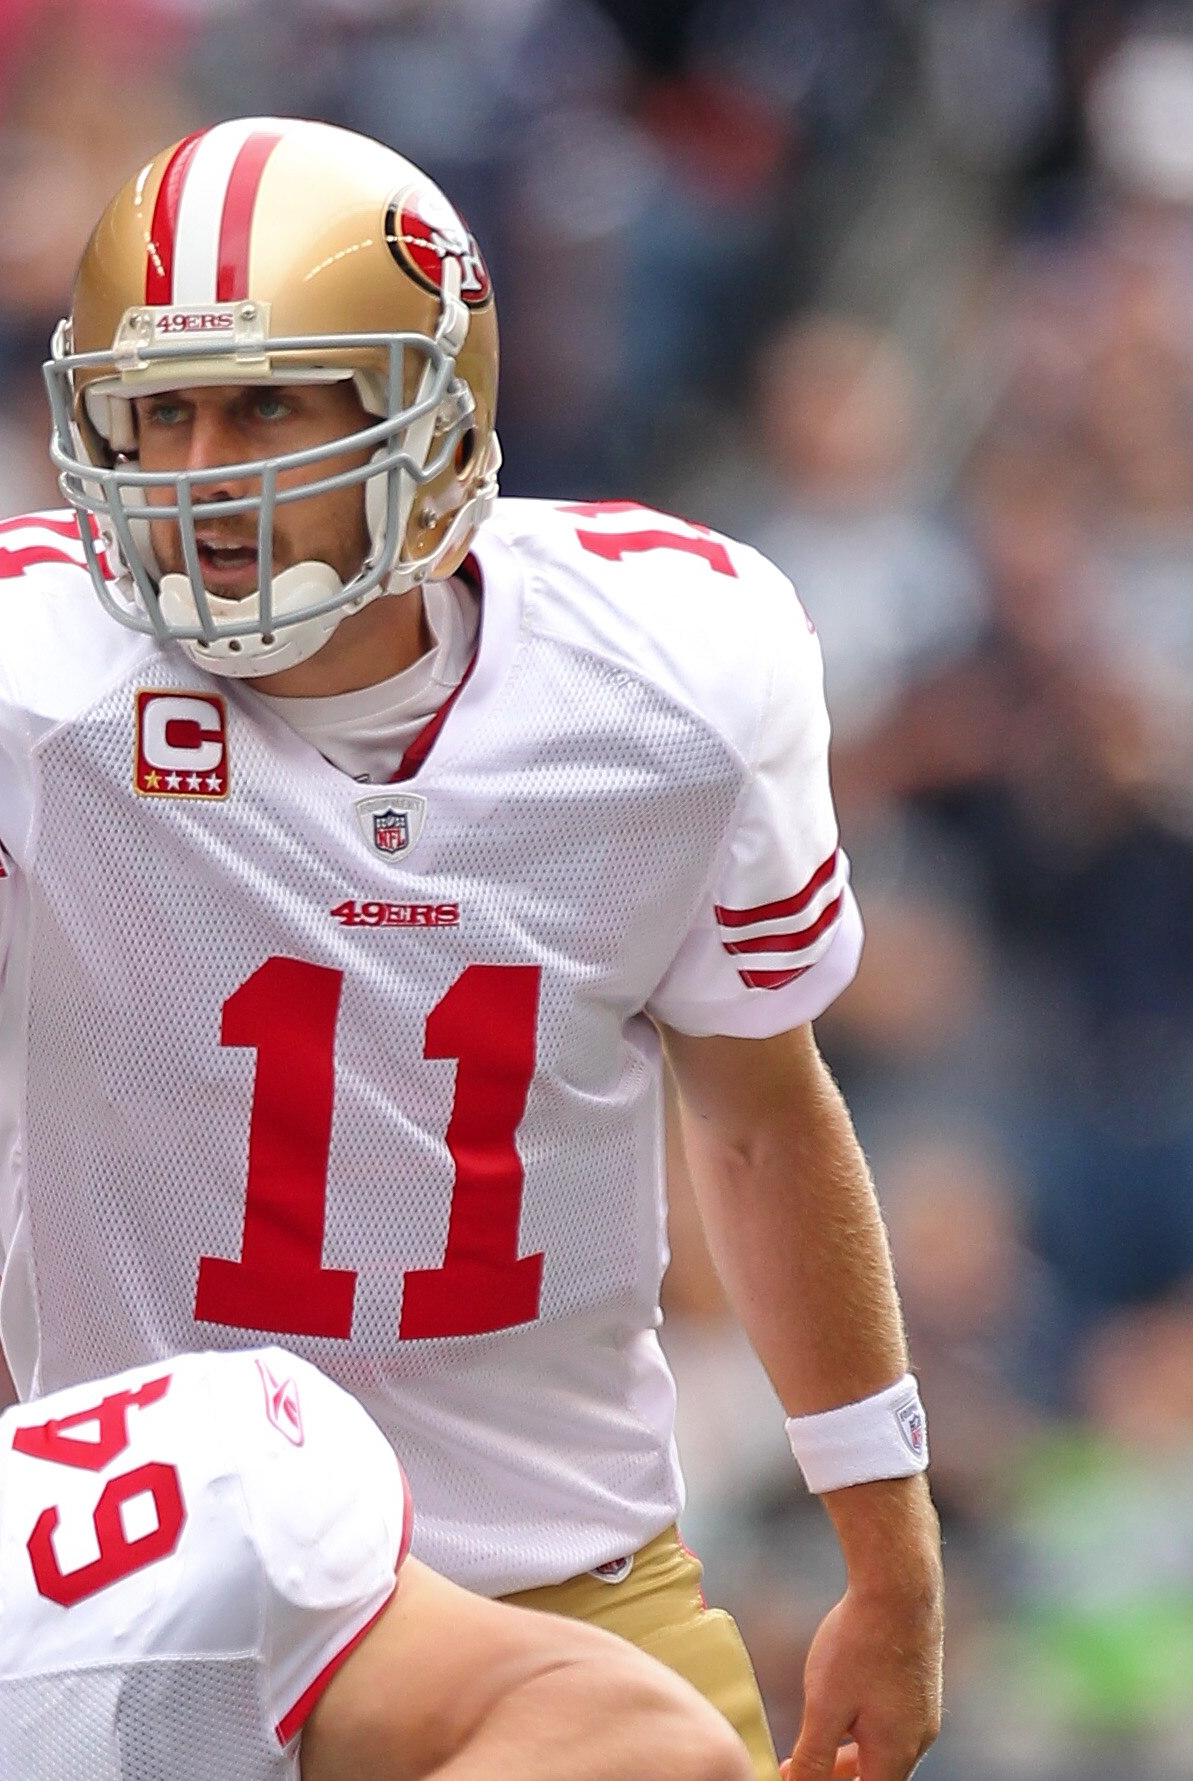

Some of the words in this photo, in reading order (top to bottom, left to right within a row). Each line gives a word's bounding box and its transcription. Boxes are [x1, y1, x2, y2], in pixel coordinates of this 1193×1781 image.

[156, 313, 234, 333] 49ERS
[143, 696, 224, 772] C
[330, 900, 460, 926] 49ERS
[194, 956, 546, 1341] 11
[11, 1373, 188, 1609] 64
